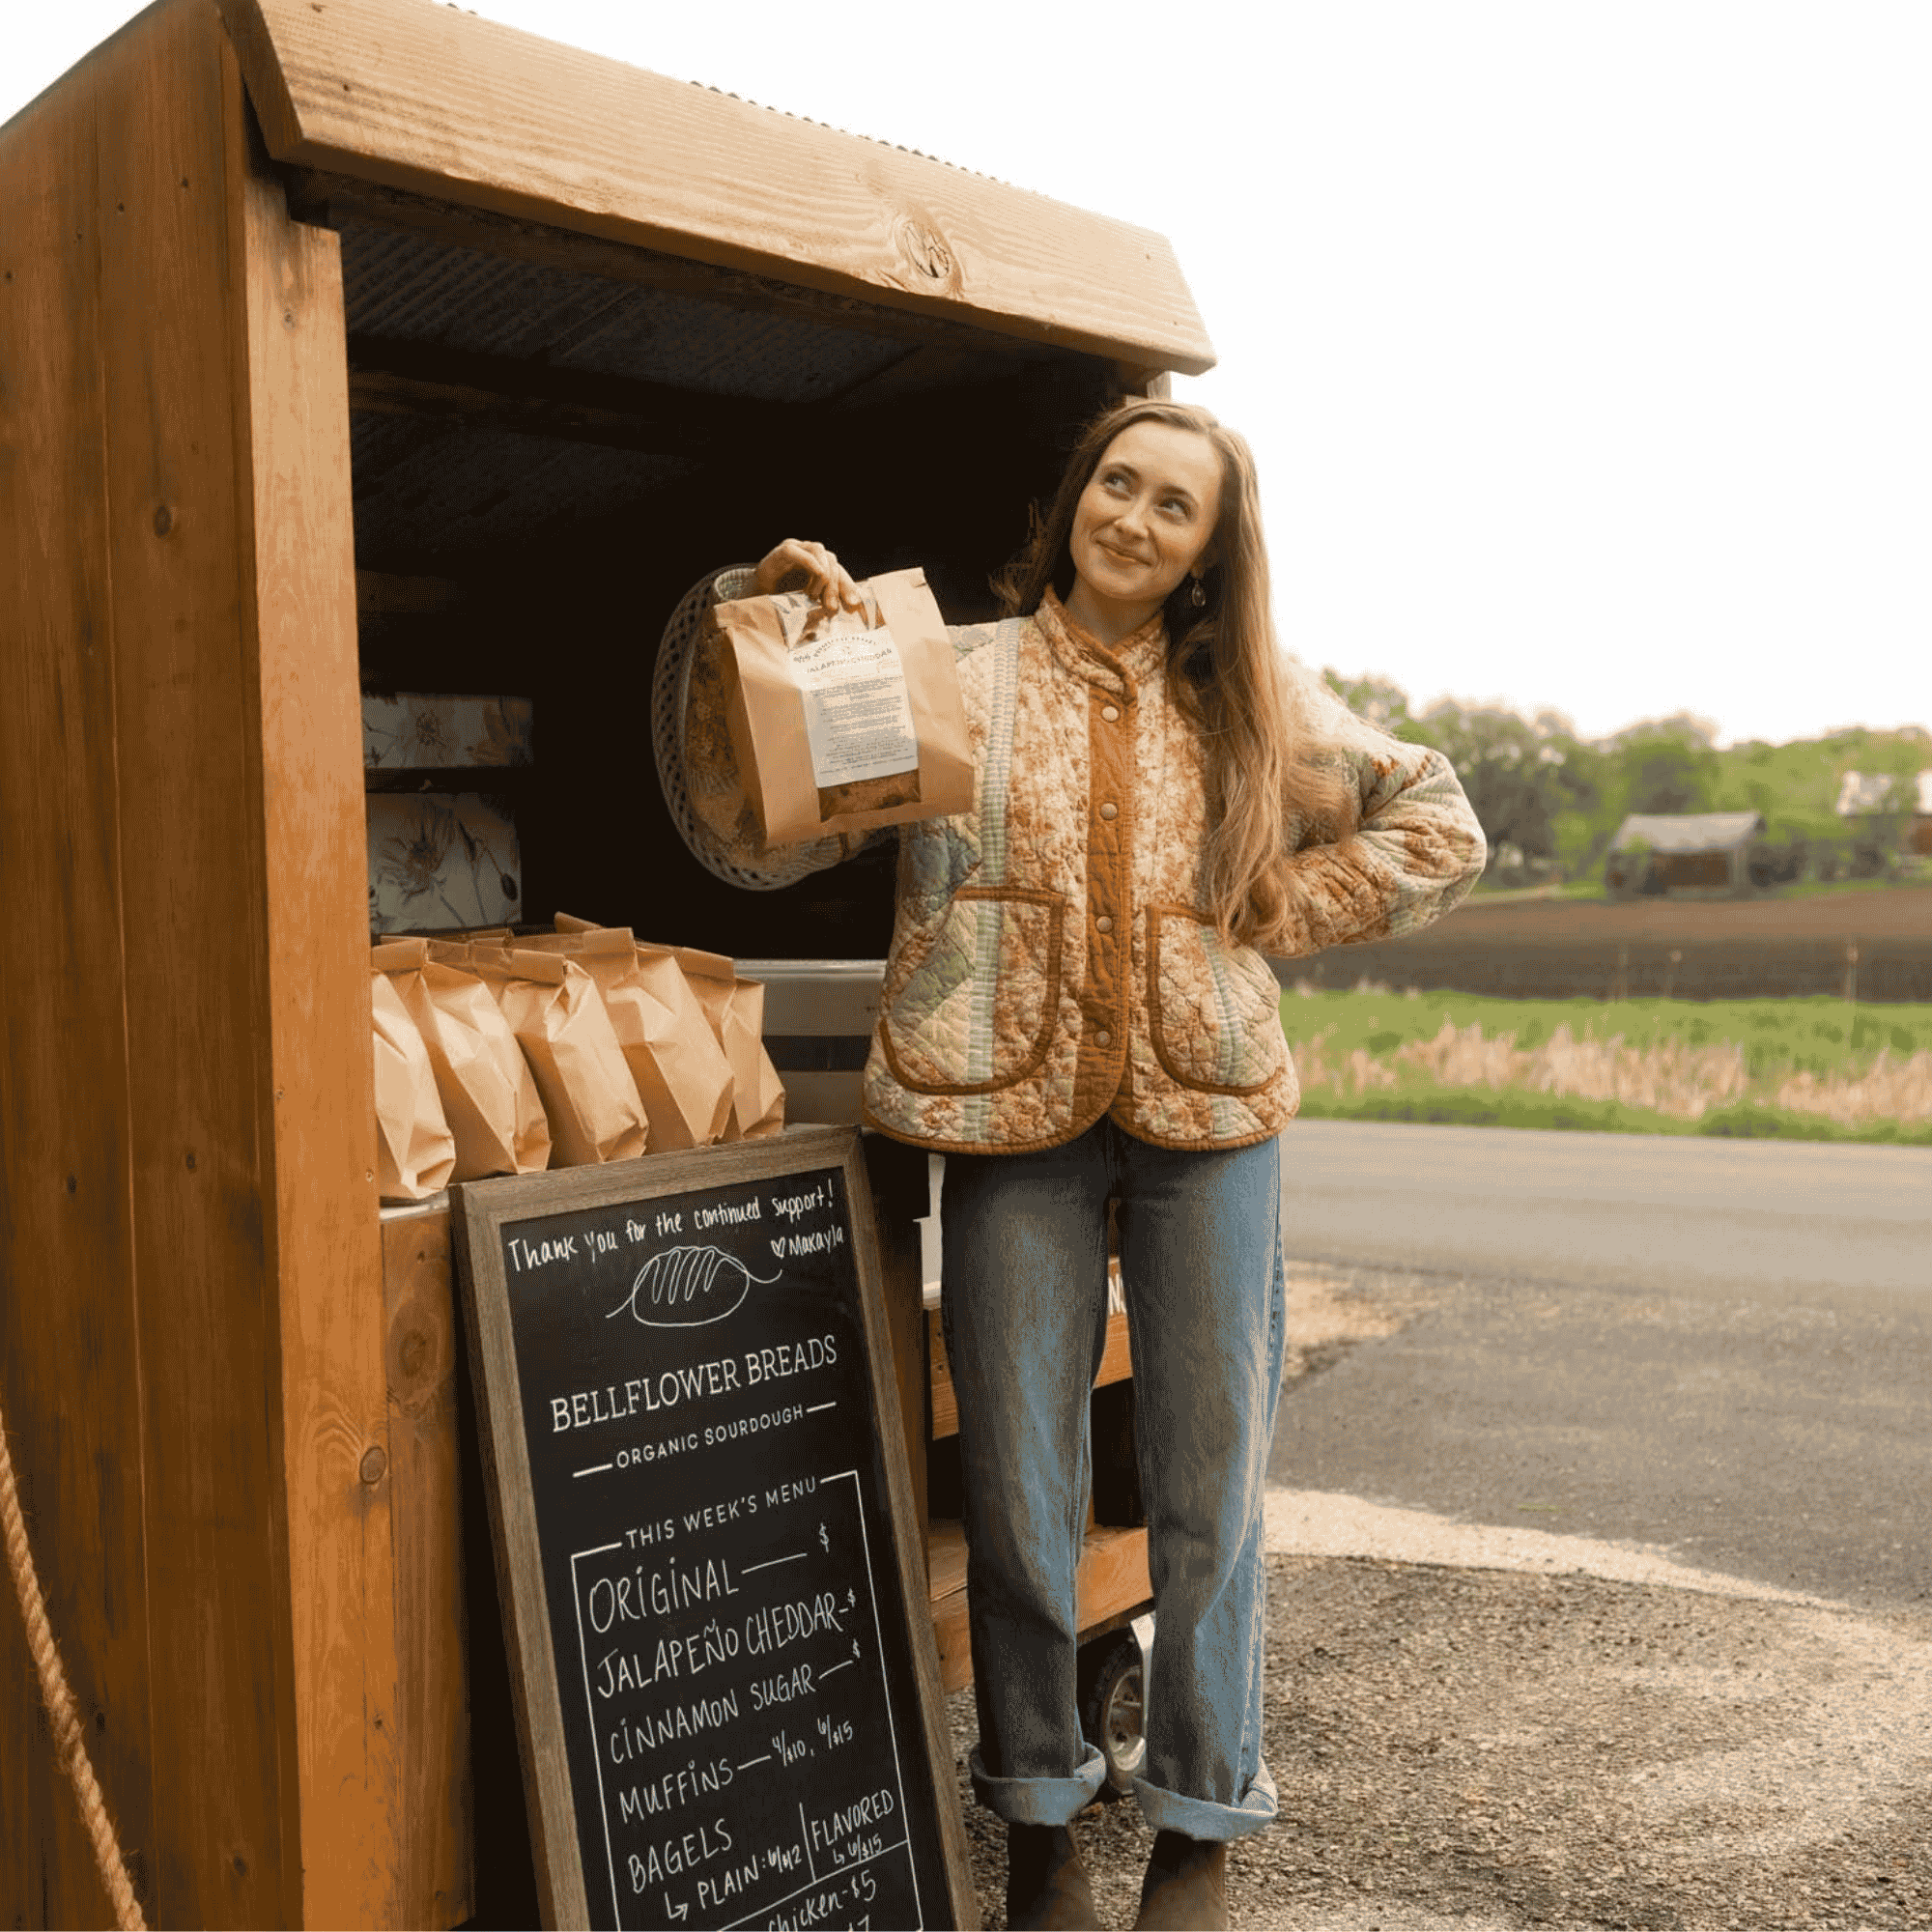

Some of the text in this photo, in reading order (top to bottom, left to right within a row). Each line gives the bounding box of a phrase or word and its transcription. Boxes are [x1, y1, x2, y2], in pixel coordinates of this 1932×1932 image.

[508, 1236, 579, 1271] Thank
[625, 1219, 646, 1242] for
[656, 1212, 683, 1236] the
[694, 1197, 761, 1230] continued
[772, 1179, 832, 1223] support!
[551, 1335, 837, 1433] BELLFLOWER BREADS
[616, 1406, 802, 1468] ORGANIC SOURDOUGH
[626, 1477, 814, 1548] THIS WEEK'S MENU
[598, 1619, 738, 1698] JALAPEÑO
[751, 1664, 815, 1710] SUGAR
[628, 1819, 731, 1893] BAGELS
[811, 1790, 894, 1851] FLAVORED
